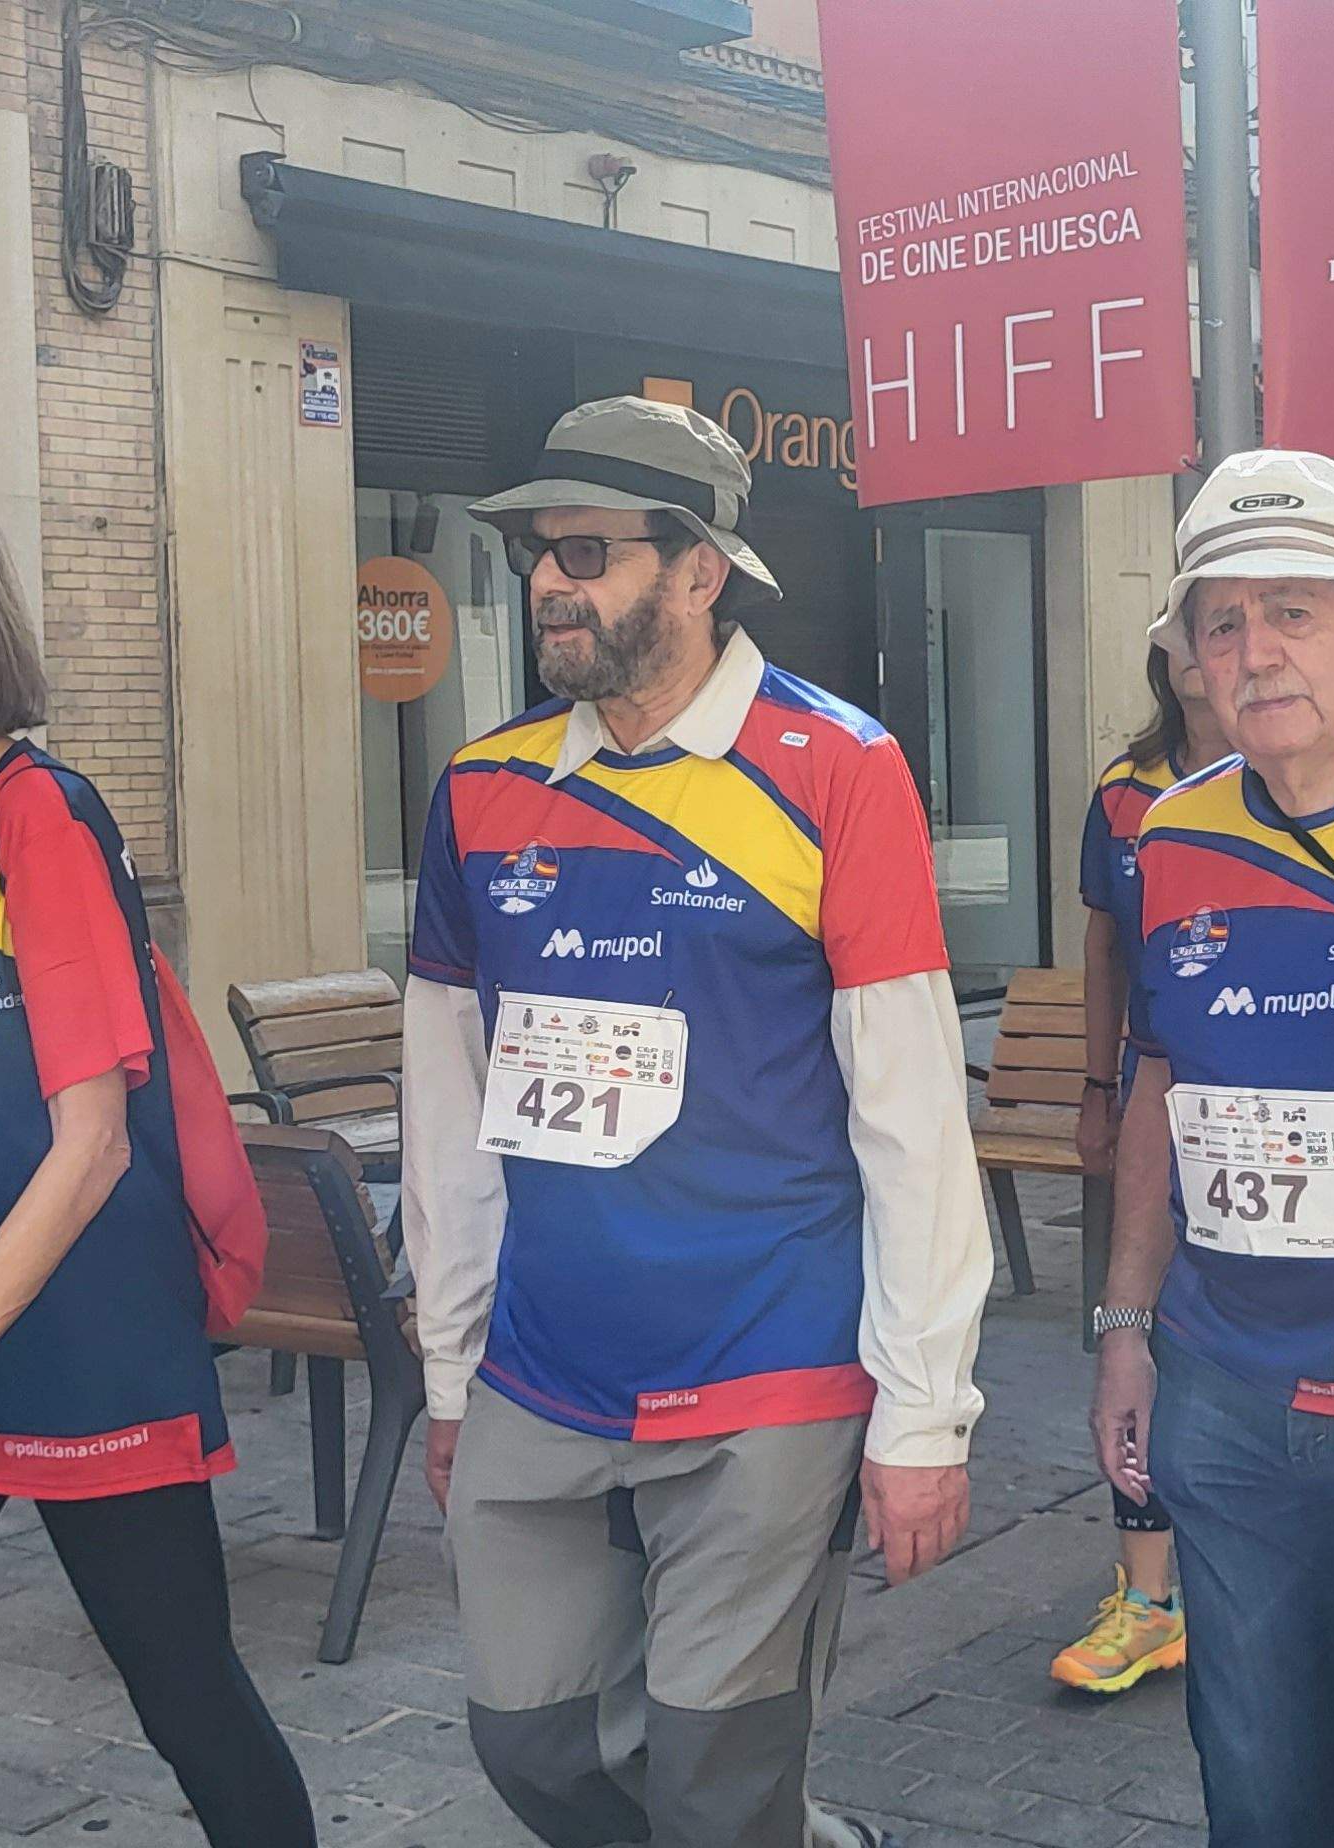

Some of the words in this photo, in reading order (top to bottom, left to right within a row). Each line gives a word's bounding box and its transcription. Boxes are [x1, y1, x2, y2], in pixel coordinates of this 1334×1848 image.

[858, 198, 954, 245] FESTIVAL
[957, 150, 1138, 219] INTERNACIONAL
[860, 248, 896, 285] DE
[902, 235, 967, 277] CINE
[974, 227, 1012, 266] DE
[1019, 207, 1141, 258] HUESCA
[864, 297, 1144, 448] HIFF
[357, 585, 429, 607] Ahorra
[358, 609, 431, 642] 360€
[650, 887, 747, 912] Santander
[590, 931, 662, 962] mupol
[517, 1077, 622, 1138] 421
[1207, 1168, 1308, 1223] 437
[3, 1427, 149, 1459] @policianacional
